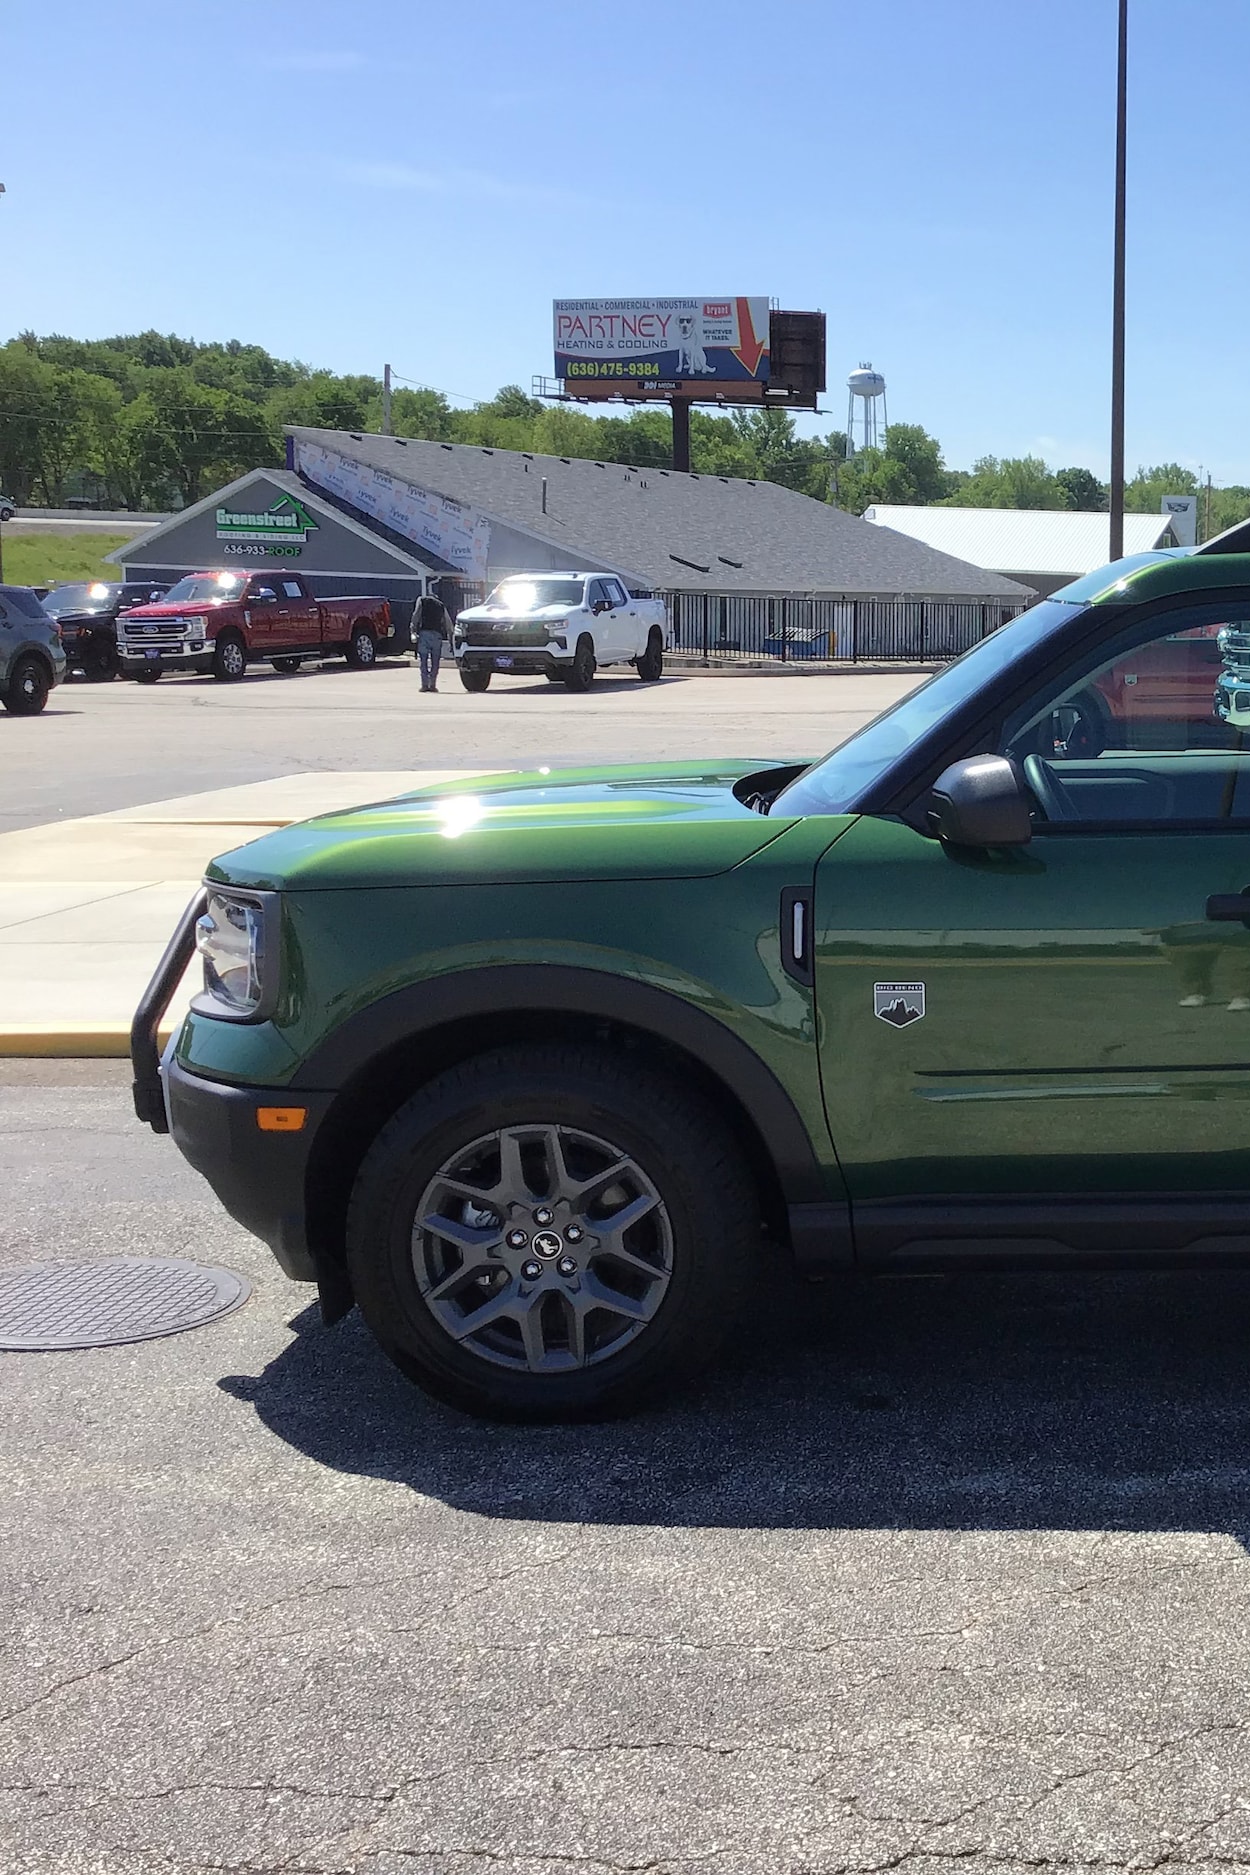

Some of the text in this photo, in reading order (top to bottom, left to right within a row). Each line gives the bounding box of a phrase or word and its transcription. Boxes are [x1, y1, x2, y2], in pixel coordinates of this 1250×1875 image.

[556, 300, 698, 311] RESIDENTIAL COMMERCIAL INDUSTRIAL
[558, 314, 672, 338] PARTNEY
[557, 340, 668, 349] HEATING & COOLING
[216, 509, 298, 527] Greenstreet
[223, 544, 301, 557] 636-933-ROOF
[451, 545, 471, 555] Tyvek
